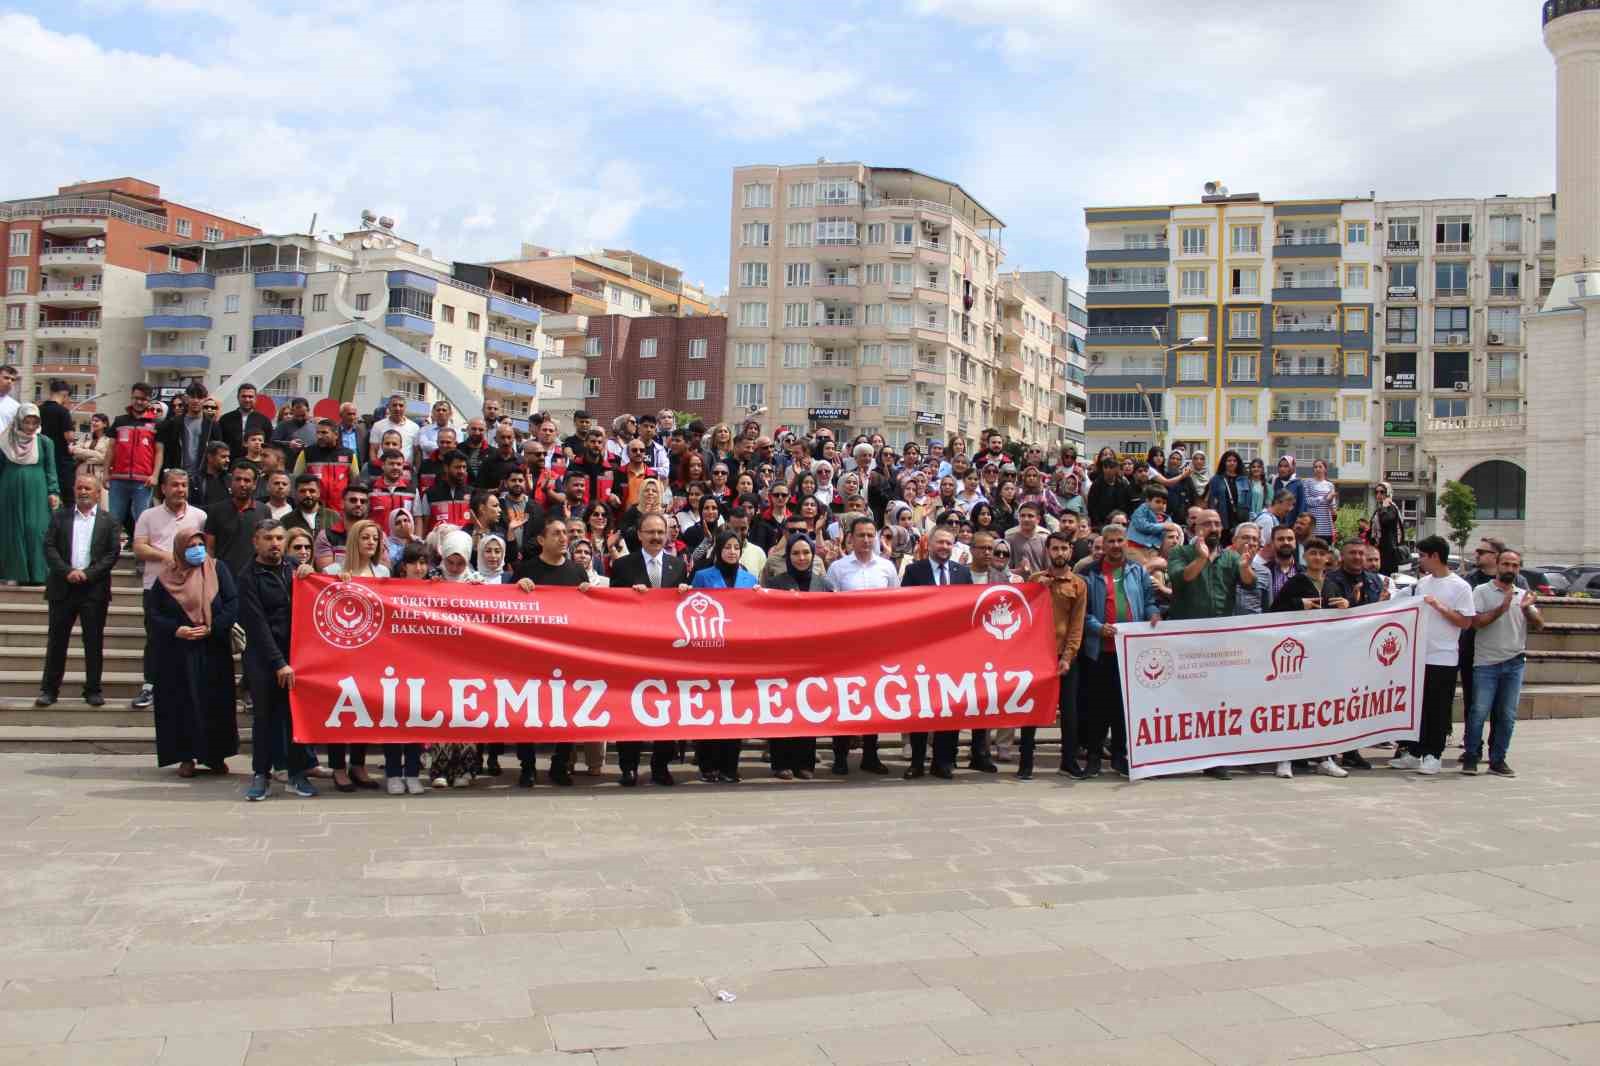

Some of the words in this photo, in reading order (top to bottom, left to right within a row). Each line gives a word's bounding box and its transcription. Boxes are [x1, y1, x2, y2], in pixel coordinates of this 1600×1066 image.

[391, 594, 448, 608] TÜRKİYE
[450, 597, 540, 611] CUMHURİYETİ
[391, 608, 420, 619] AİLE
[441, 612, 488, 623] SOSYAL
[491, 611, 569, 625] HİZMETLERİ
[391, 623, 463, 636] BAKANLIĞI
[325, 666, 611, 728] AİLEMİZ
[630, 663, 1035, 727] GELECEĞİMİZ
[1136, 702, 1242, 746] AİLEMİZ
[1250, 680, 1407, 734] GELECEĞİMİZ
